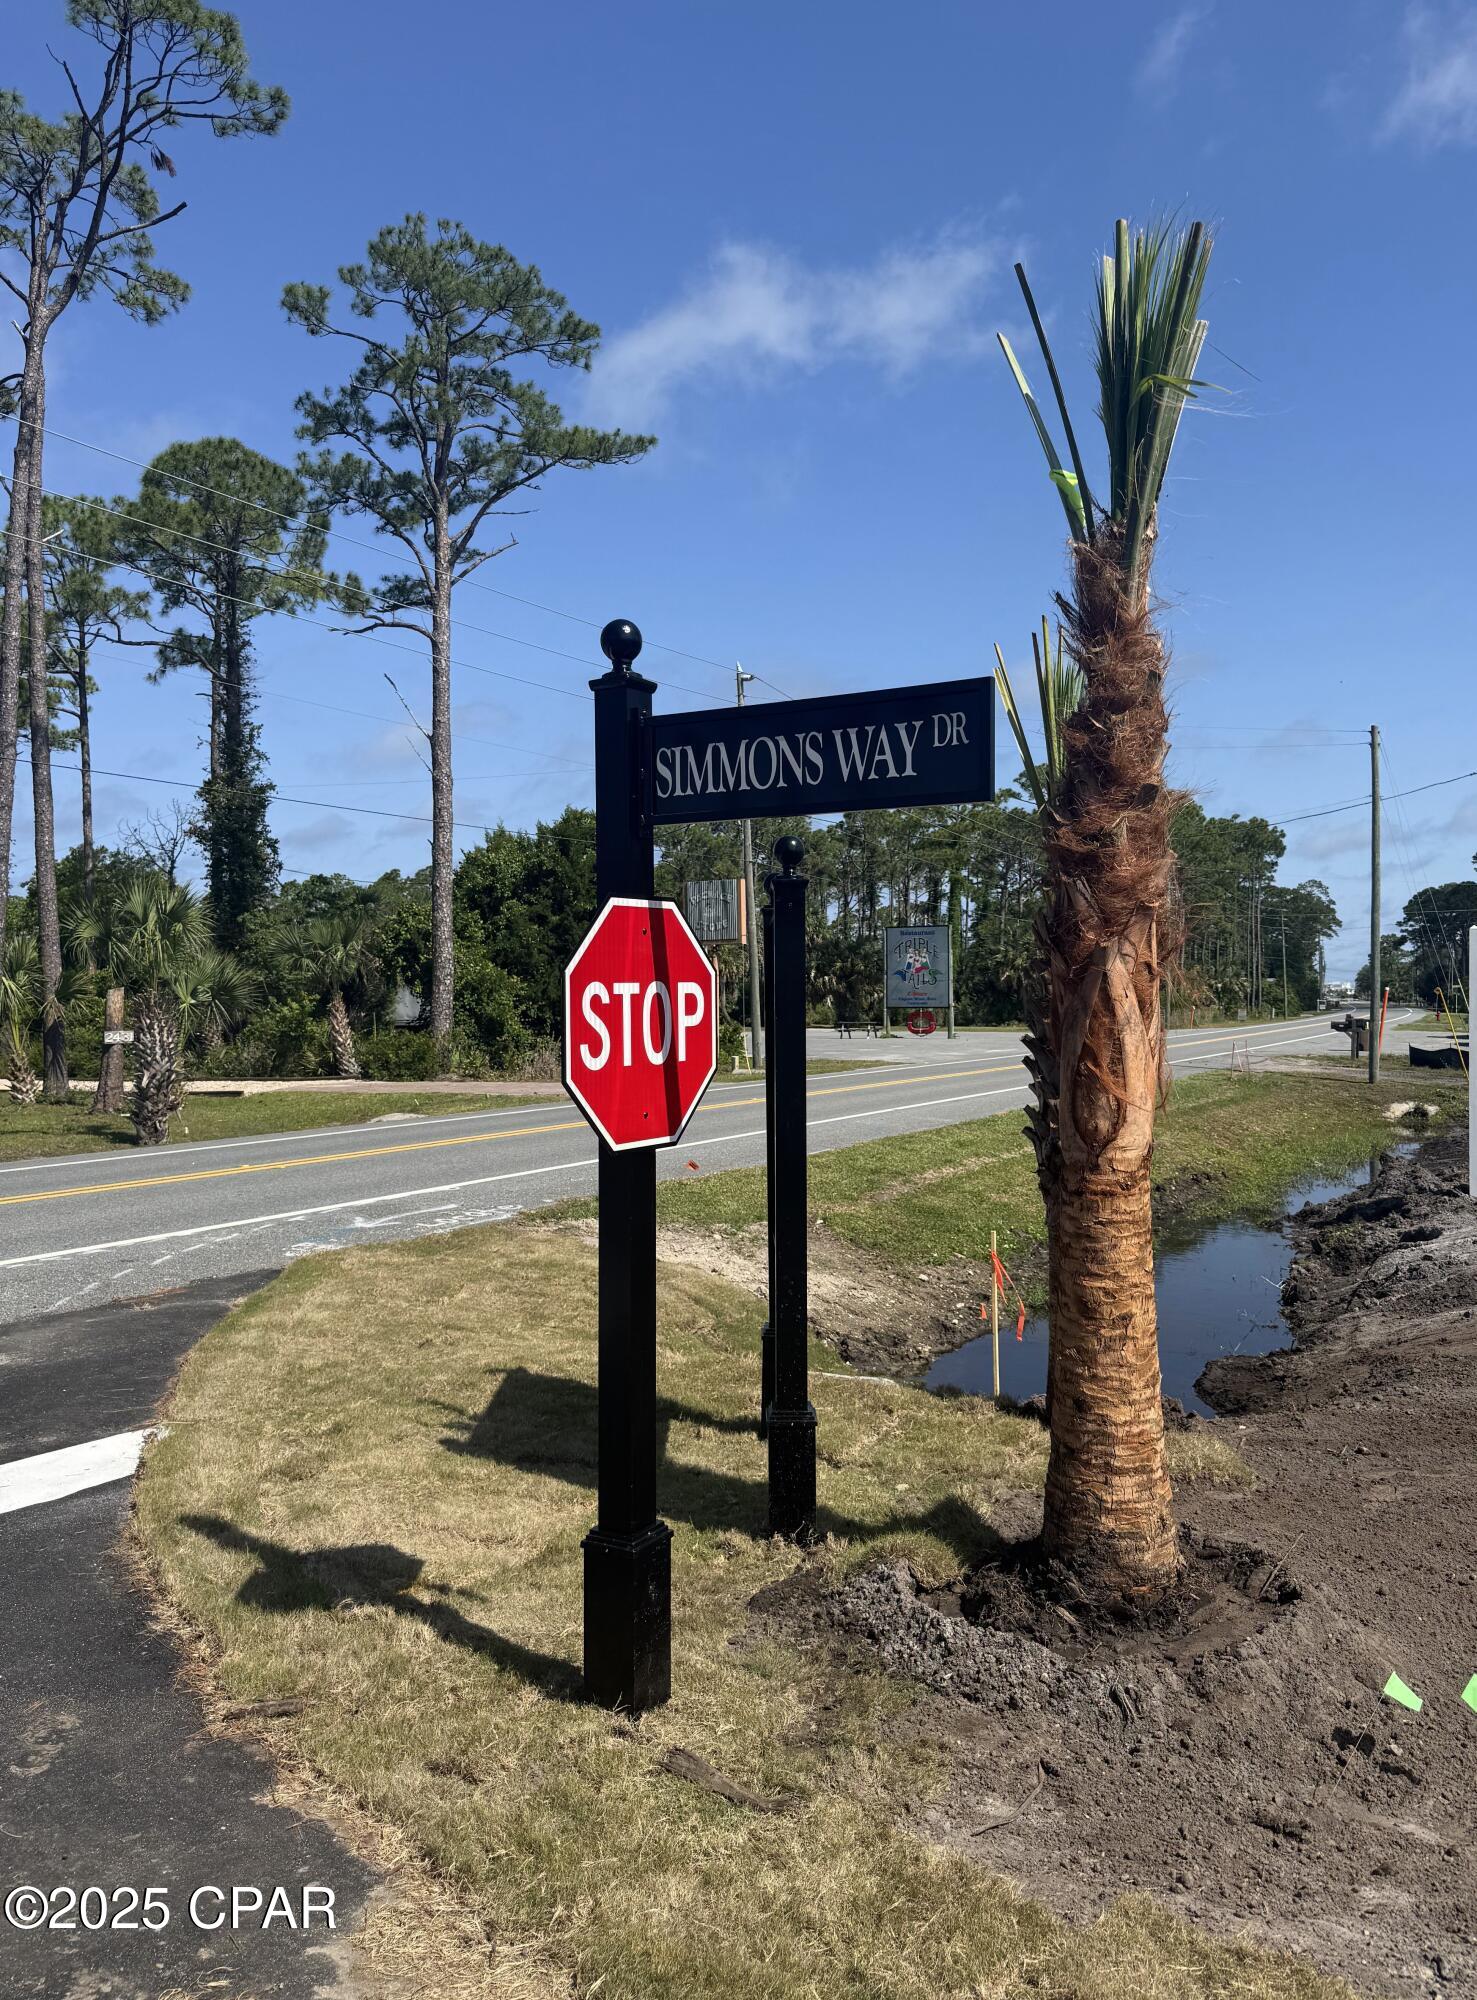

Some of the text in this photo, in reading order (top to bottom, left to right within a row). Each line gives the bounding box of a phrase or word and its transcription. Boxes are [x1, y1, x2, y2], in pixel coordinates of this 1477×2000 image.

[656, 711, 969, 798] SIMMONS WAY DR
[894, 937, 940, 959] TRIPLE
[580, 980, 705, 1072] STOP
